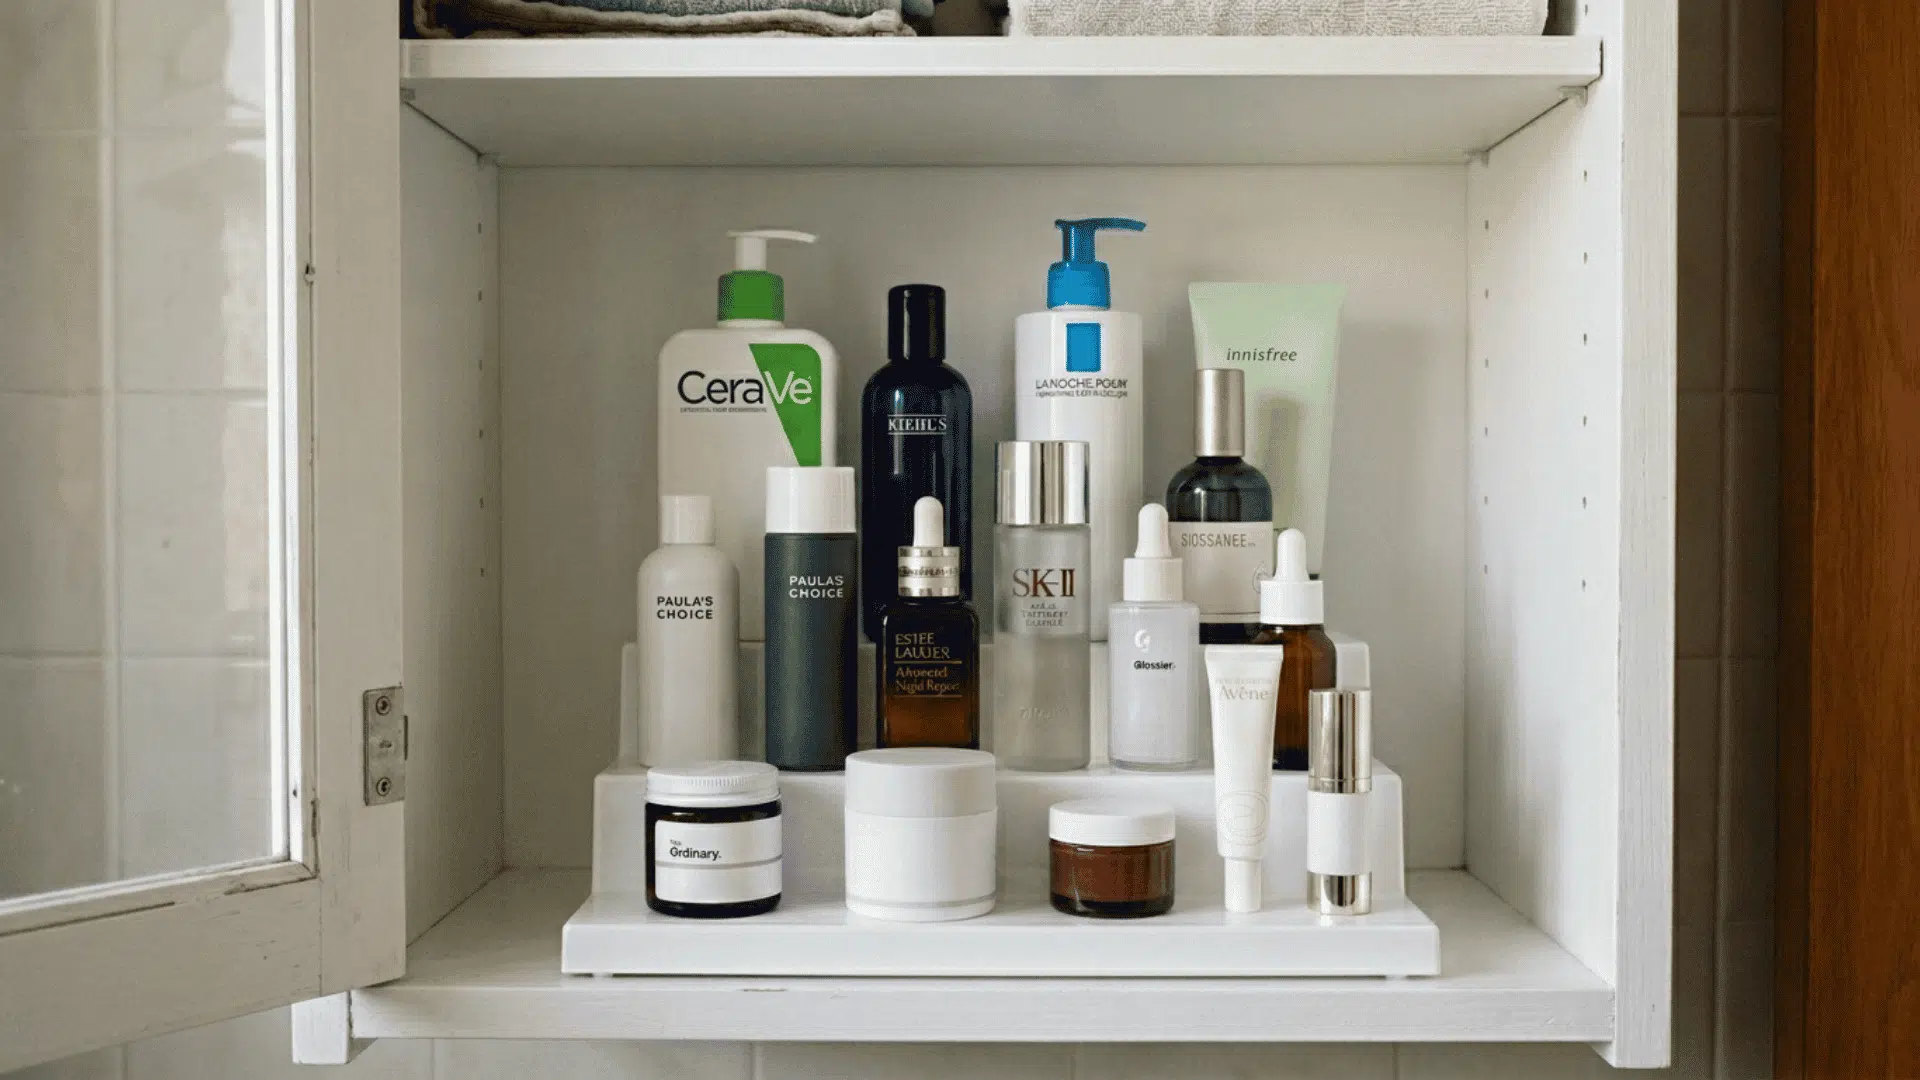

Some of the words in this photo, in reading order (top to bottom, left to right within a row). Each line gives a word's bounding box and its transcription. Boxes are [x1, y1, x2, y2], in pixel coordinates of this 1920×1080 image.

[1226, 347, 1298, 362] innisfree
[677, 370, 813, 405] CeraVe
[1012, 568, 1075, 597] SK-II
[789, 588, 844, 599] CHOICE
[657, 595, 714, 607] PAULA'S
[657, 609, 714, 620] CHOICE
